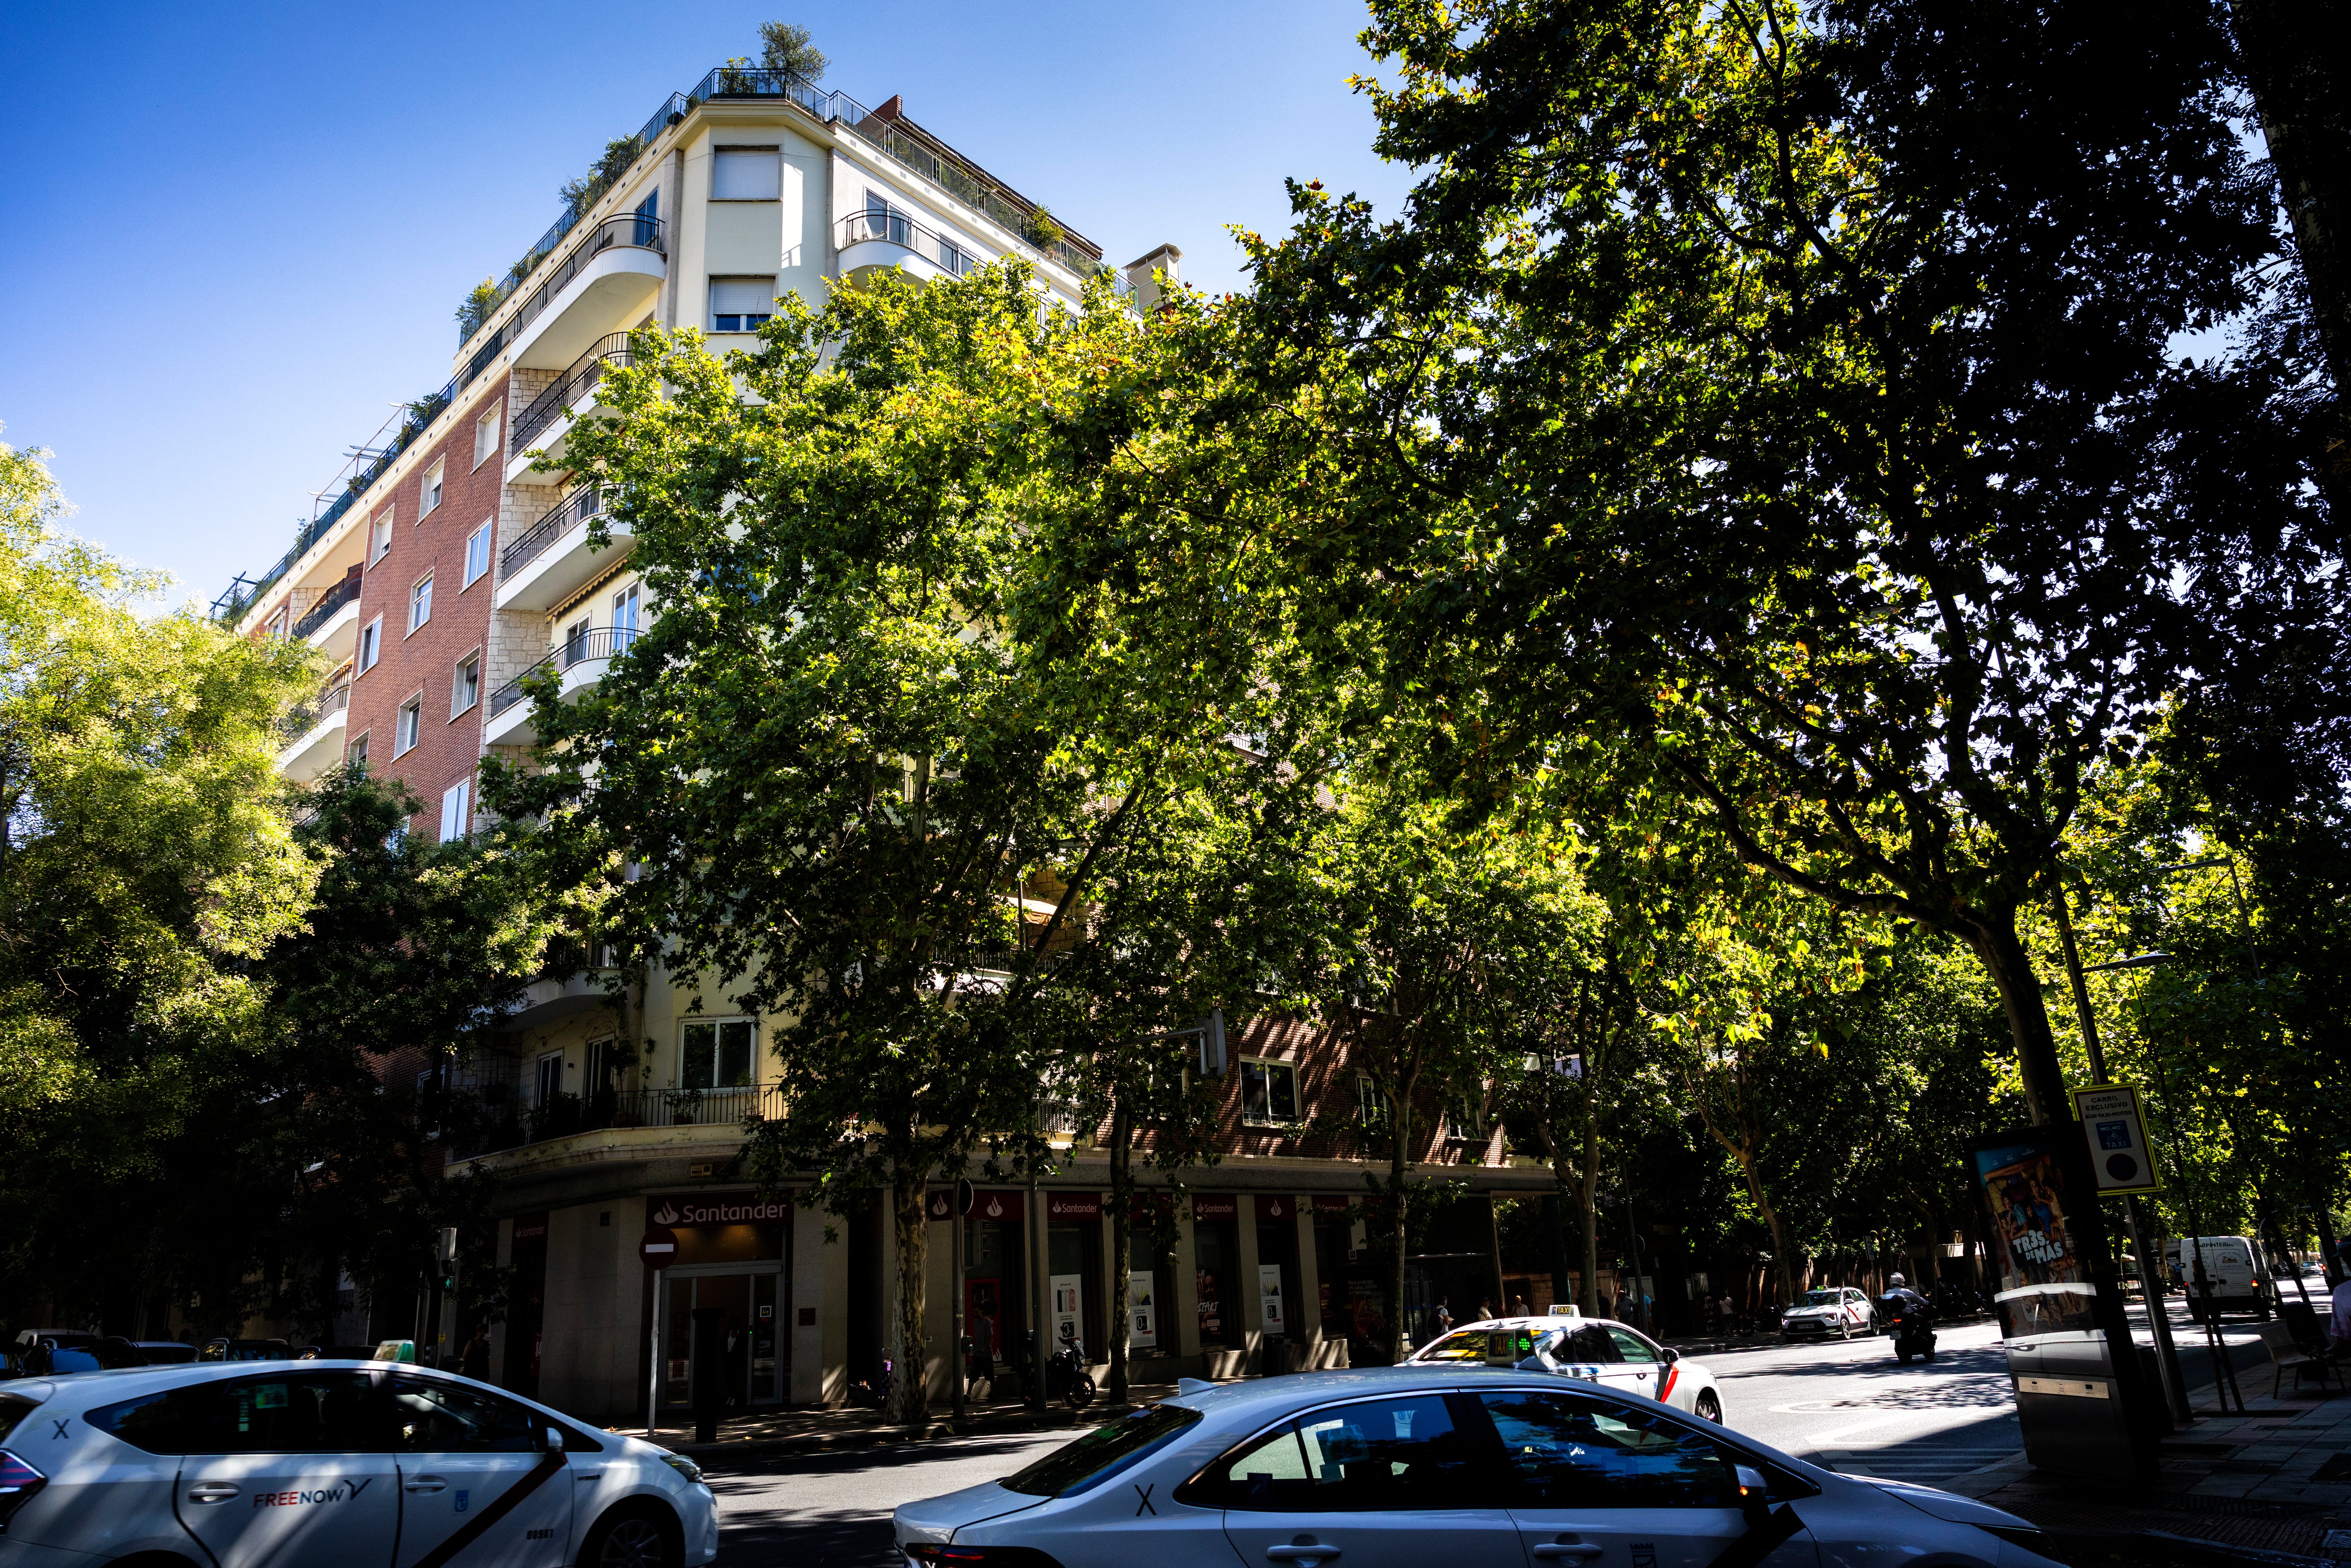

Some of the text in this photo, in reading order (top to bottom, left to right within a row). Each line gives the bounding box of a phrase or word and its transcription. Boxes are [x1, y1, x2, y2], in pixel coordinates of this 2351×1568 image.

[2085, 1102, 2128, 1111] EXCLUSIVO
[2085, 1110, 2132, 1119] BUS-TAXI-MOTOS
[683, 1202, 787, 1222] Santander
[1062, 1203, 1097, 1213] Santander
[1205, 1204, 1233, 1213] Santander
[521, 1224, 545, 1237] Santander
[2012, 1229, 2046, 1254] TR3S
[2025, 1240, 2064, 1264] DE MÁS
[1198, 1301, 1219, 1313] START
[1494, 1336, 1508, 1354] TAXI
[52, 1418, 71, 1440] X
[1134, 1483, 1157, 1517] X
